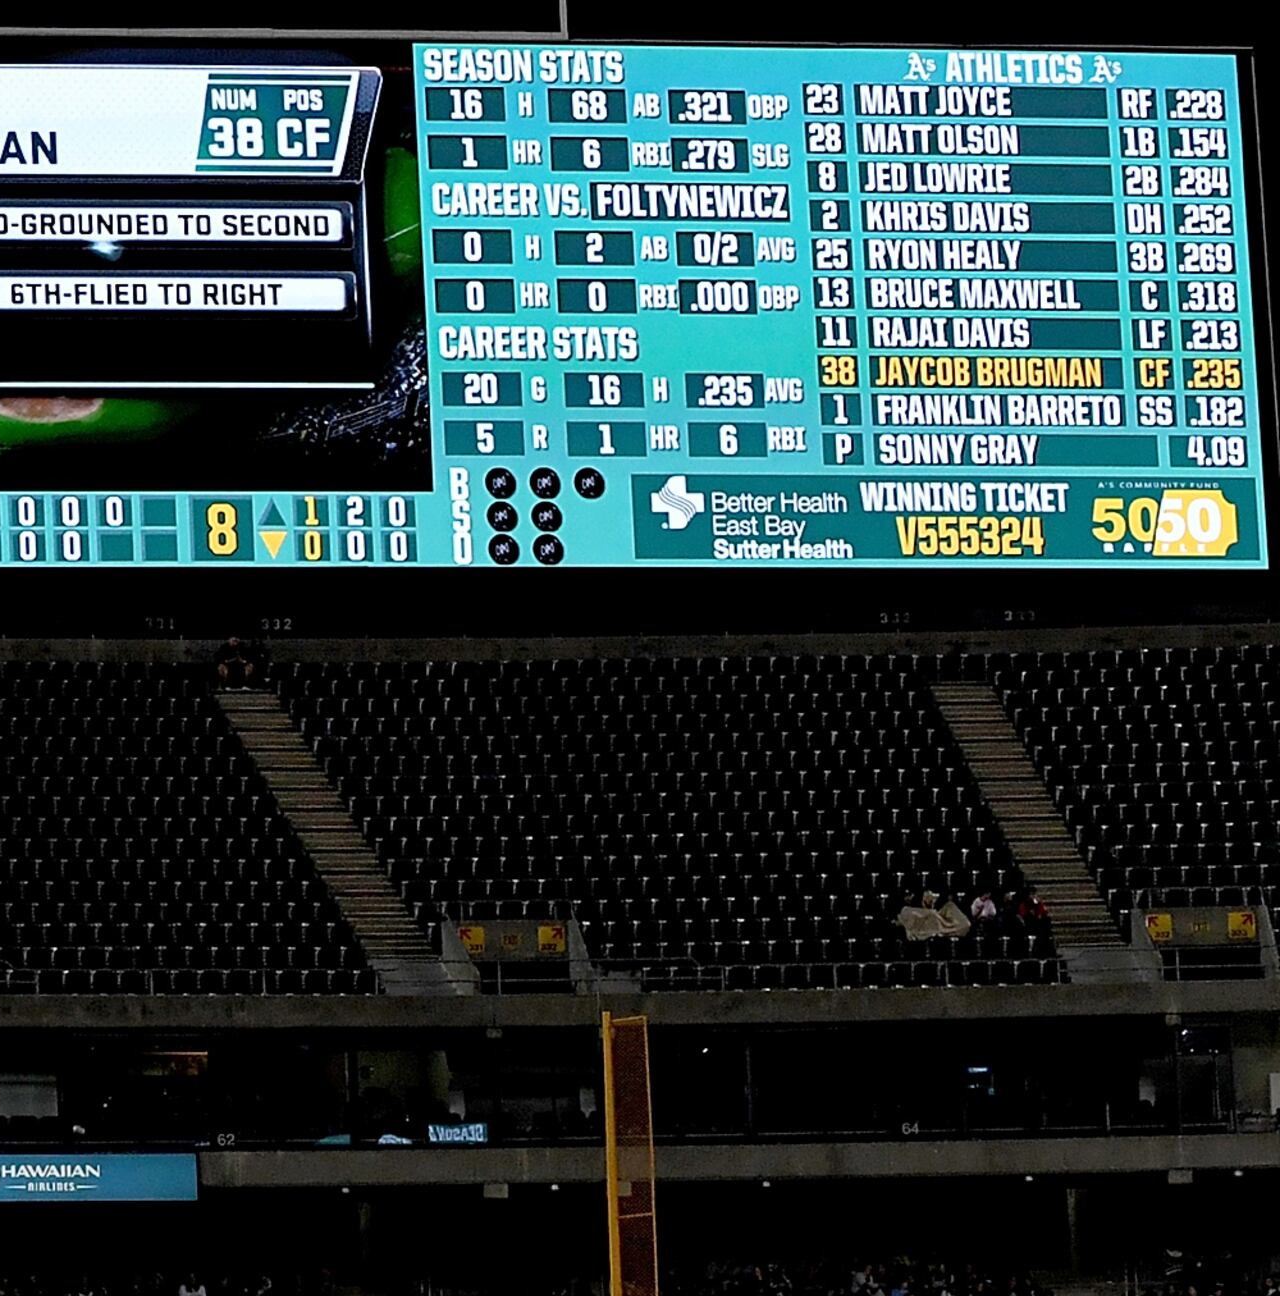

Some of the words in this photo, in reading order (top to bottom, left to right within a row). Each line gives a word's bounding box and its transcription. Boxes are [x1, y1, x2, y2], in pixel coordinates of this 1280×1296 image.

[424, 50, 532, 82] SEASON
[540, 51, 623, 83] STATS
[945, 54, 1082, 83] ATHLETICS
[212, 90, 256, 110] NUM
[284, 90, 323, 110] POS
[860, 85, 929, 115] MATT
[936, 87, 1011, 116] JOYCE
[208, 119, 262, 157] 38
[277, 119, 329, 157] CF
[862, 124, 931, 153] MATT
[938, 125, 1018, 153] OLSON
[866, 162, 908, 191] JED
[915, 163, 1011, 192] LOWRIE
[432, 183, 538, 216] CAREER
[544, 184, 588, 217] VS.
[596, 185, 787, 218] FOLTYNEWICZ
[179, 215, 212, 236] TO
[223, 215, 329, 236] SECOND
[866, 202, 946, 231] KHRIS
[953, 202, 1029, 232] DAVIS
[871, 279, 953, 308] BRUCE
[960, 280, 1080, 309] MAXWELL
[440, 327, 546, 359] CAREER
[553, 328, 637, 359] STATS
[873, 318, 948, 348] RAJAI
[954, 319, 1029, 348] DAVIS
[876, 357, 971, 387] JAYCOB
[977, 358, 1101, 388] BRUGMAN
[878, 396, 1002, 425] FRANKLIN
[1008, 398, 1120, 426] BARRETO
[880, 434, 964, 463] SONNY
[971, 435, 1037, 464] GRAY
[711, 492, 774, 513] Better
[781, 493, 847, 514] Health
[860, 482, 975, 512] WINNING
[981, 484, 1068, 513] TICKET
[207, 503, 237, 555] 8
[713, 515, 761, 536] East
[764, 515, 805, 541] Bay
[896, 517, 1045, 555] V555324
[713, 539, 781, 560] Sutter
[784, 540, 853, 560] Health
[1, 1164, 101, 1178] HAWAIIAN
[28, 1181, 76, 1191] AIRLINES
